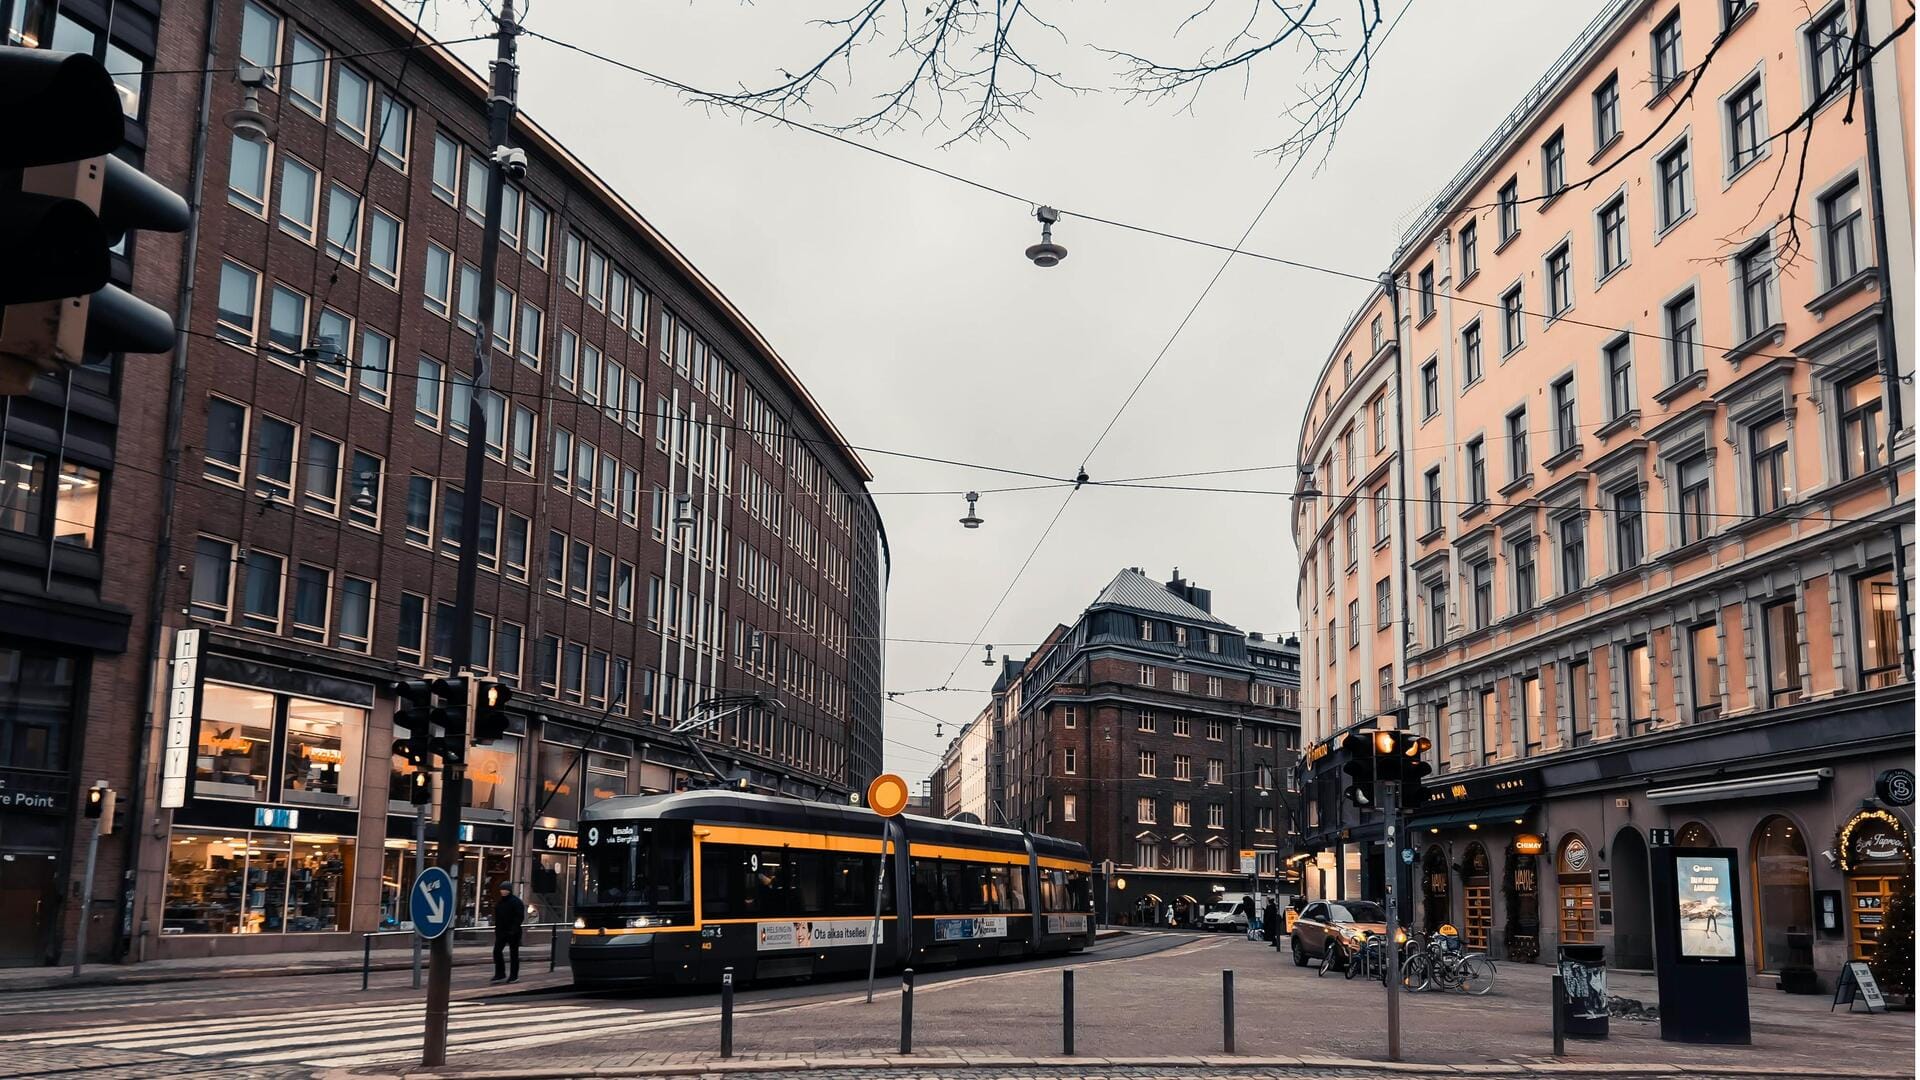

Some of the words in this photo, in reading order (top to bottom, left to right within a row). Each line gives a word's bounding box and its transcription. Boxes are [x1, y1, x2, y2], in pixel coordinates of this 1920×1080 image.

[172, 632, 193, 775] HOBBY
[15, 793, 54, 807] Point
[588, 827, 599, 846] 9
[751, 854, 758, 871] 9
[814, 929, 825, 940] Ota
